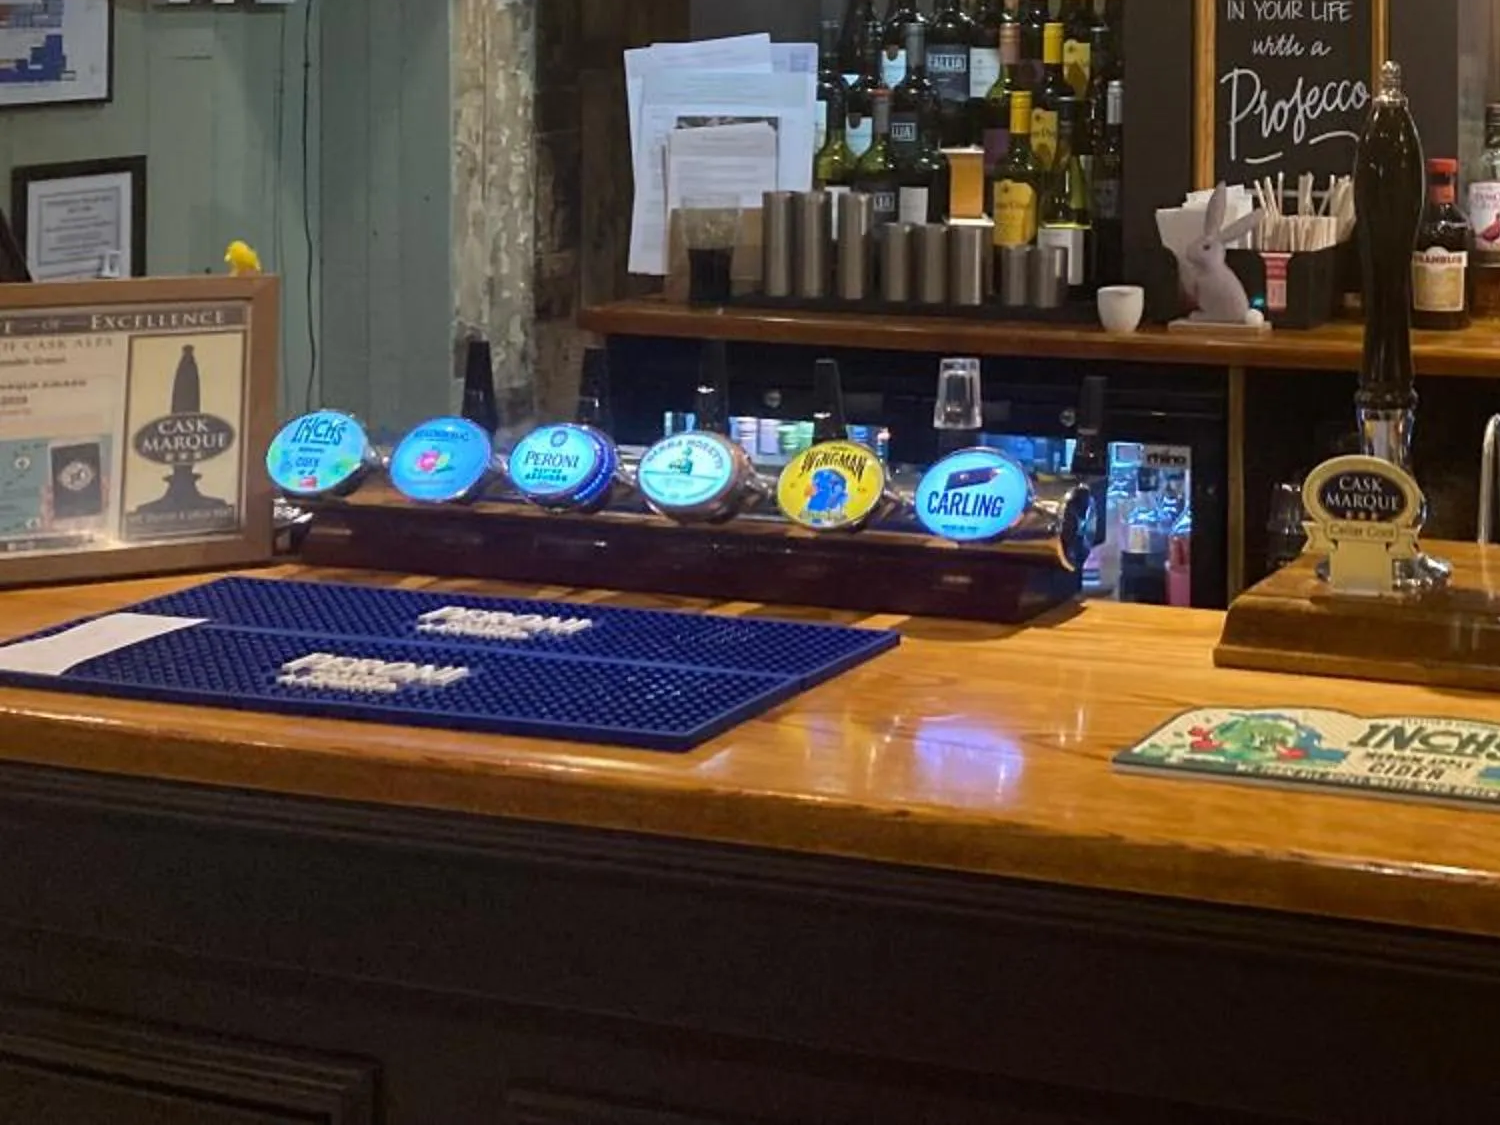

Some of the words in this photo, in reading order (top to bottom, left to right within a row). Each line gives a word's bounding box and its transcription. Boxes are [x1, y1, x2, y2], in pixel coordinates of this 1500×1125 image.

[1226, 0, 1246, 21] IN
[1253, 0, 1304, 22] YOUR
[1311, 0, 1355, 22] LIFE
[1252, 33, 1305, 57] with
[1310, 39, 1333, 57] a
[91, 310, 226, 331] EXCELLENCE
[157, 417, 210, 437] CASK
[142, 431, 227, 453] MARQUE
[525, 451, 580, 469] PERONI
[799, 450, 867, 482] WINGMAN
[1339, 476, 1384, 495] CASK
[926, 491, 1005, 518] CARLING
[1325, 492, 1399, 513] MARQUE
[1367, 762, 1446, 780] CIDER
